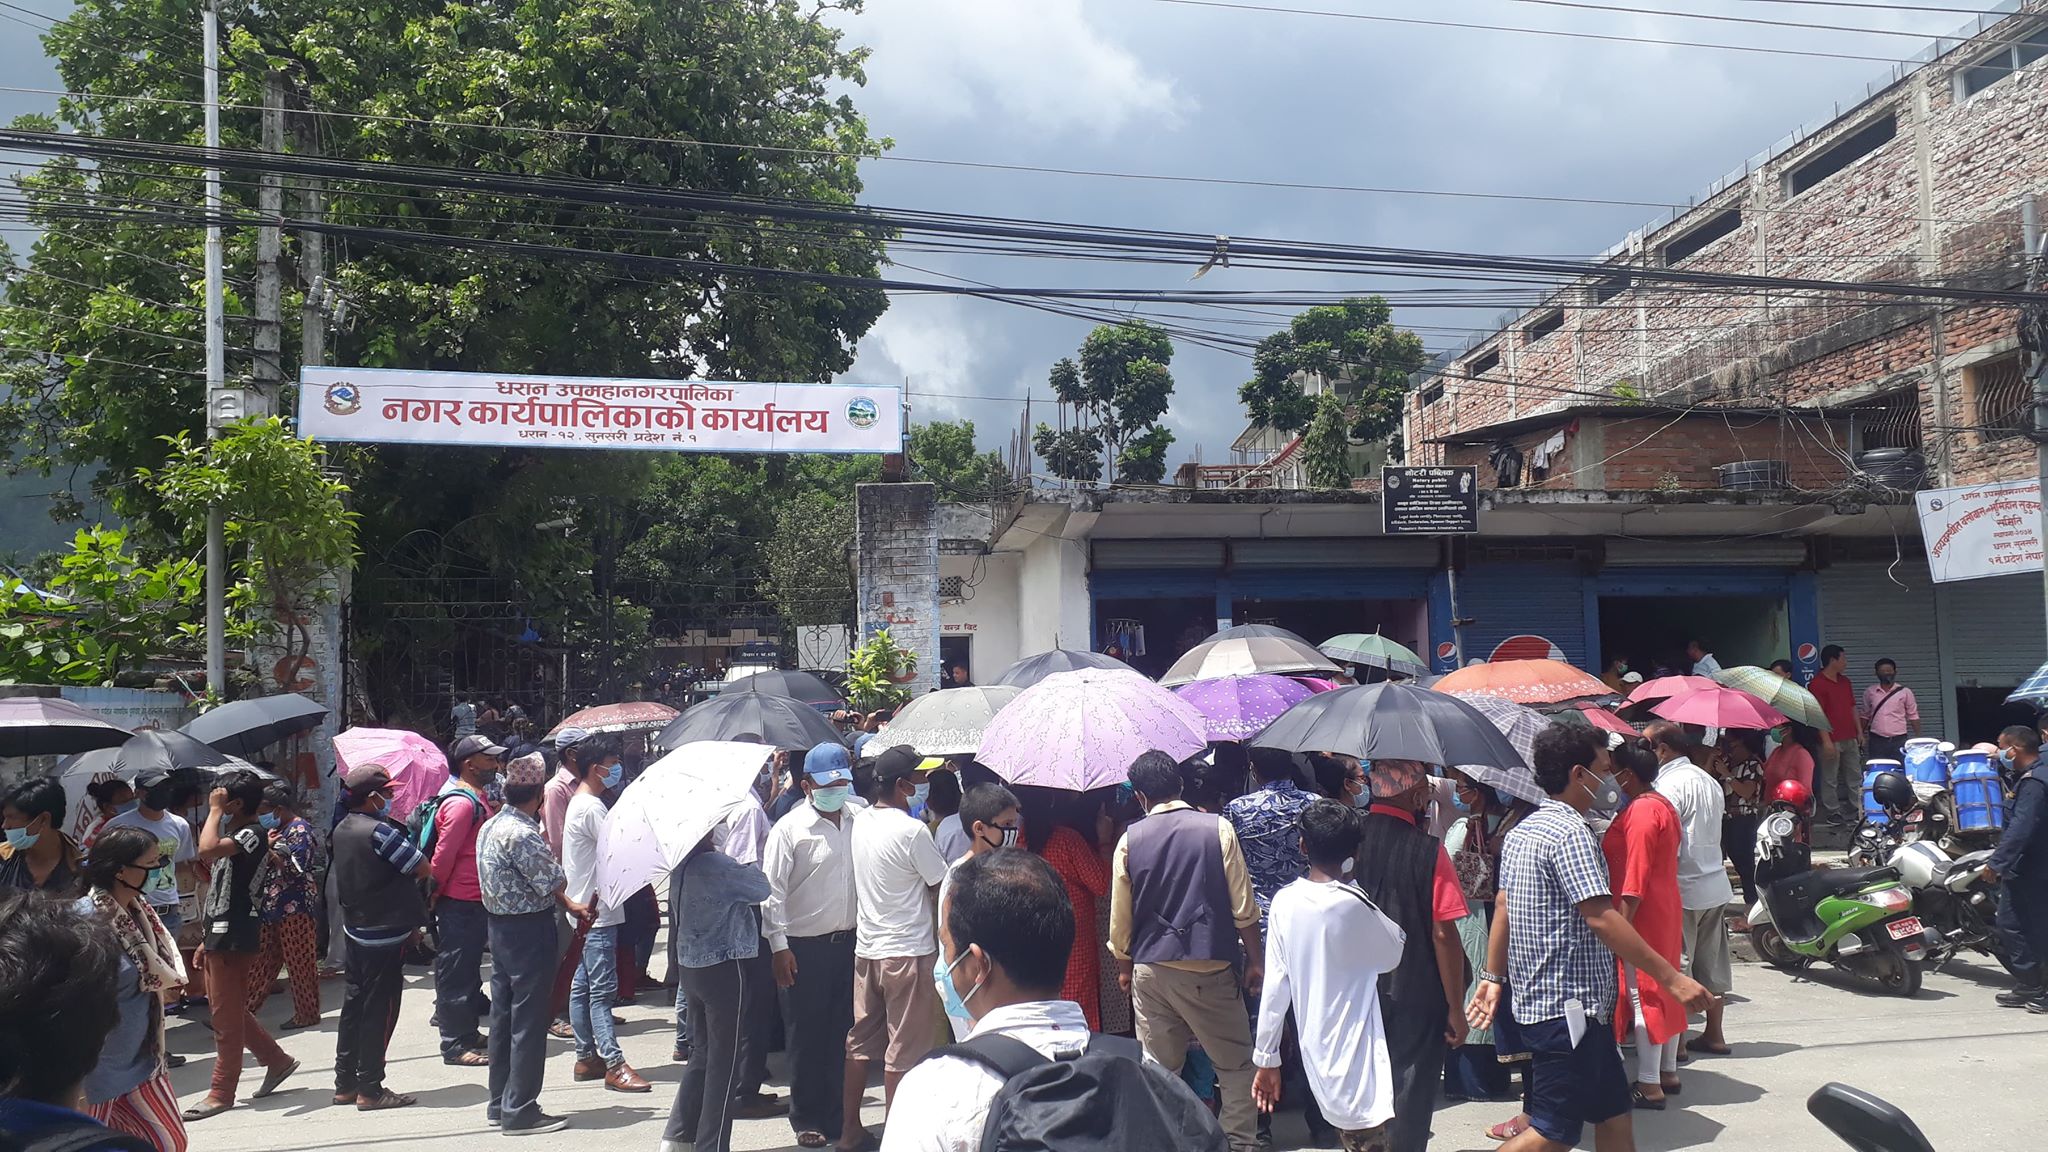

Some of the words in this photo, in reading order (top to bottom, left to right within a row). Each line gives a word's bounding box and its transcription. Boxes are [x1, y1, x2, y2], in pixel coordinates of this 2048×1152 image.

[496, 381, 549, 396] धरान
[556, 383, 734, 401] उपमहानगरपालिका
[382, 398, 463, 426] नगर
[468, 396, 696, 431] कार्यपालिकाको
[701, 403, 829, 433] कार्यालय
[518, 430, 547, 439] धरान
[584, 431, 626, 443] सुनसरी
[634, 432, 664, 444] प्रदेश
